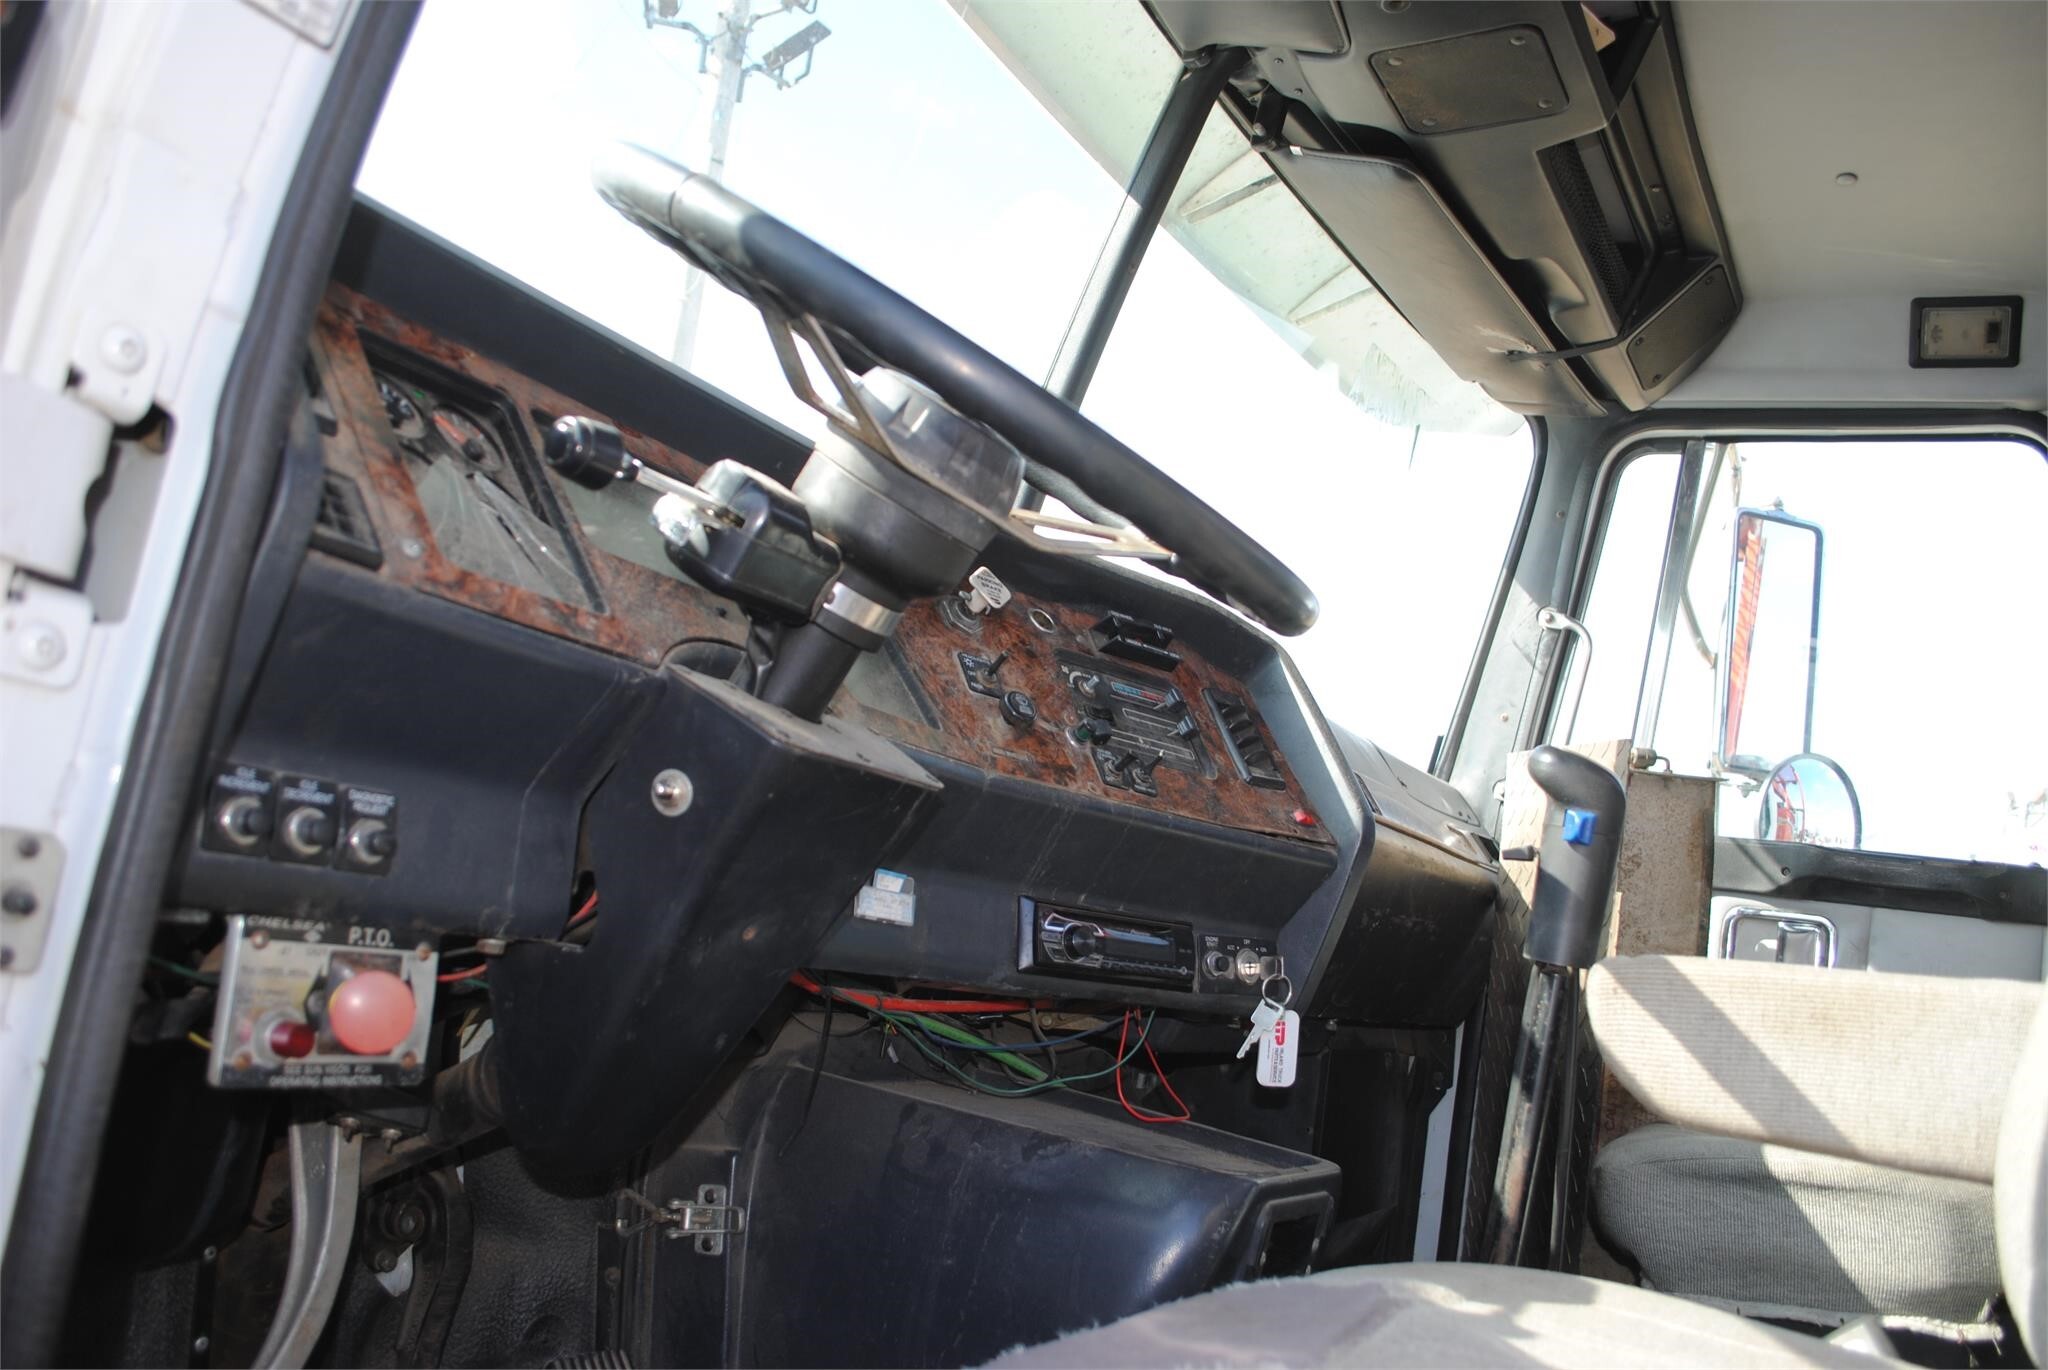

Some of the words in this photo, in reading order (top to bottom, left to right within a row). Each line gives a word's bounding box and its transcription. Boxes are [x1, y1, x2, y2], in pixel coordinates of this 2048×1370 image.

[246, 914, 326, 931] CHELSEA
[348, 926, 394, 948] P.T.O.
[268, 1075, 320, 1088] OPERATING
